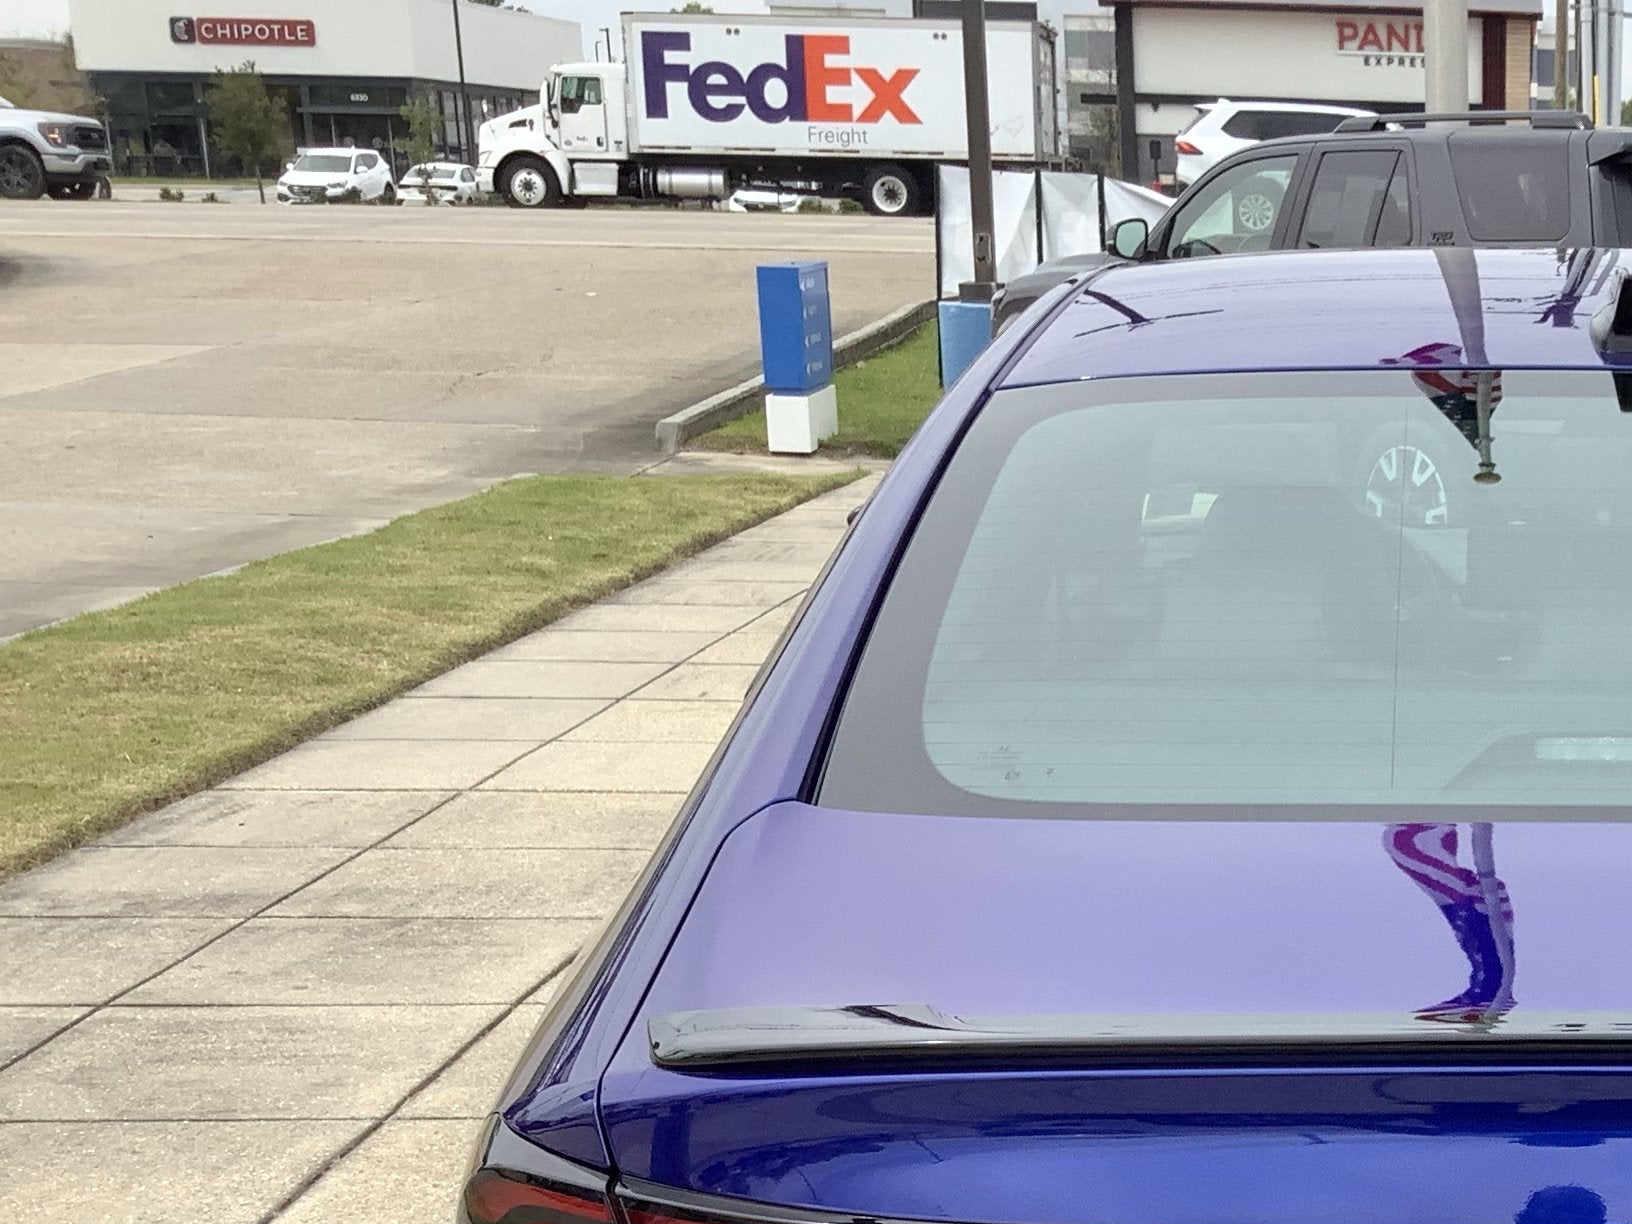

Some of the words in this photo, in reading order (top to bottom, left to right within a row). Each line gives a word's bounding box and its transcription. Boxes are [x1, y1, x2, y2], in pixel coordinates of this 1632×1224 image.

[200, 23, 309, 41] CHIPOTLE
[641, 31, 923, 124] FedEx
[808, 126, 868, 147] Freight
